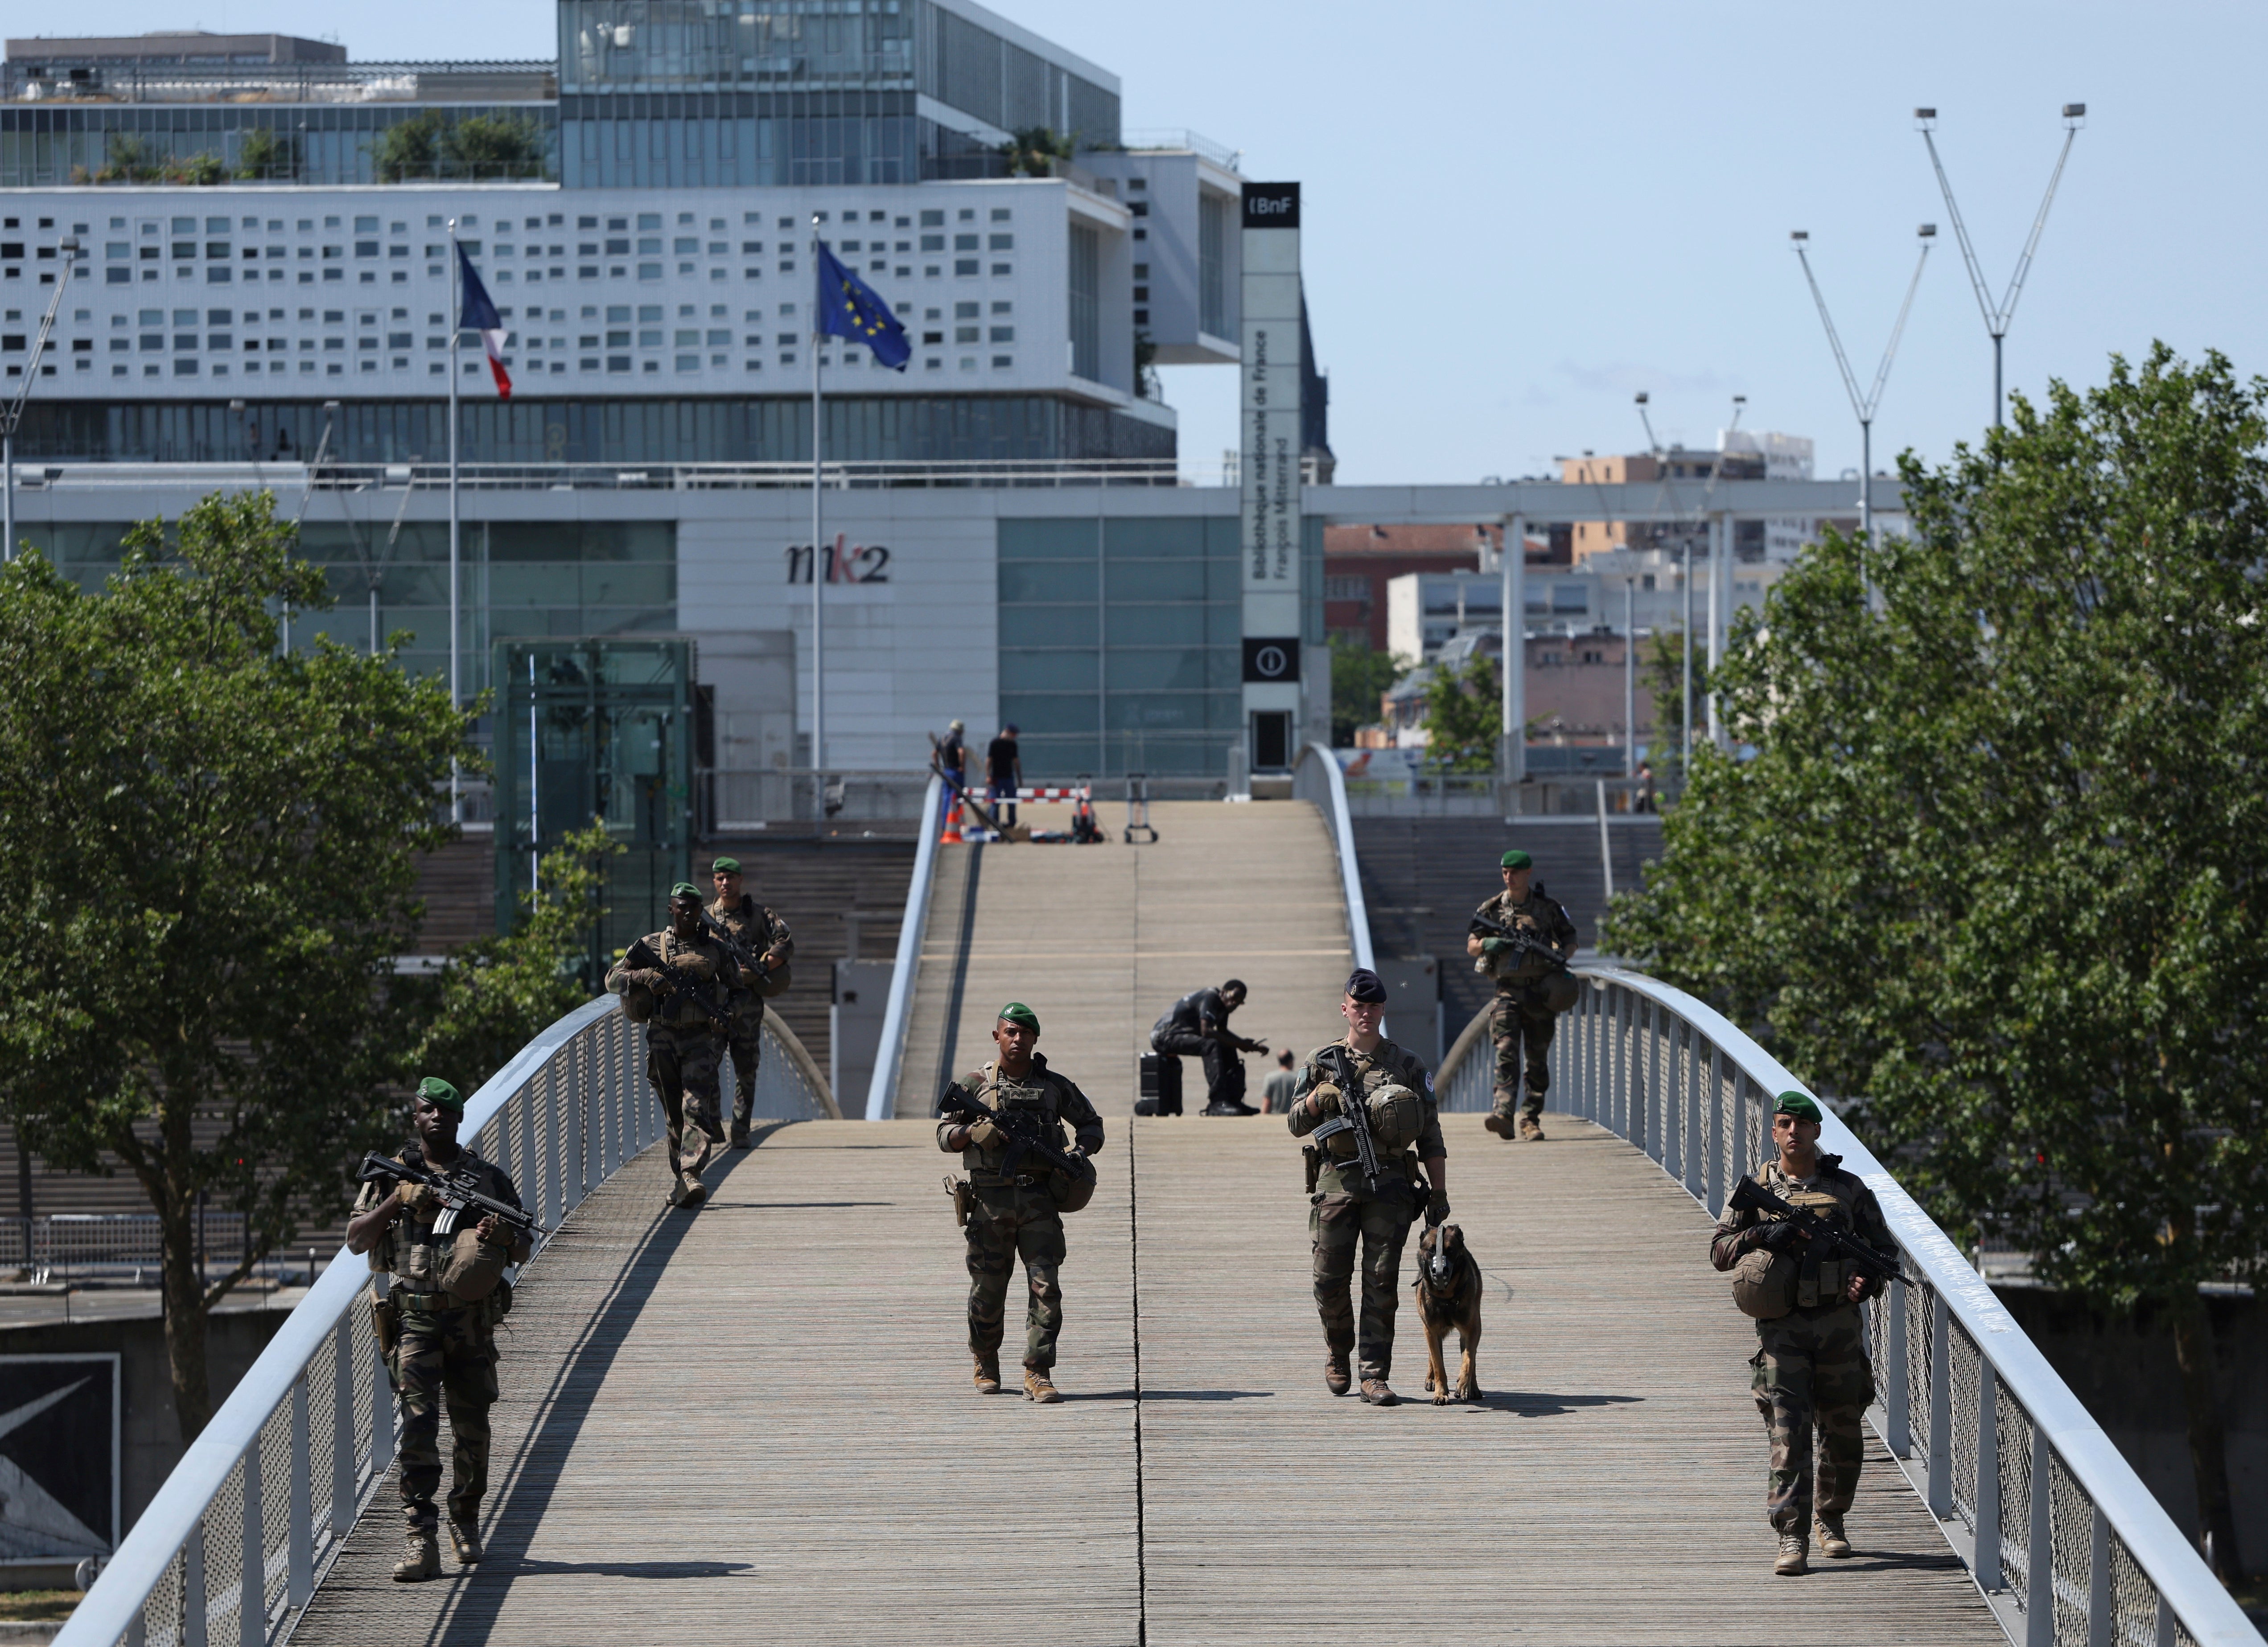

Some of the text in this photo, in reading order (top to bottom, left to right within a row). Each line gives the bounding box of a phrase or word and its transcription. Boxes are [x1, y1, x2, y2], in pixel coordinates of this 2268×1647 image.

[1252, 330, 1269, 579] Bibliothèque nationale de France
[1273, 438, 1290, 579] François Mitterrand
[785, 533, 890, 584] mk2
